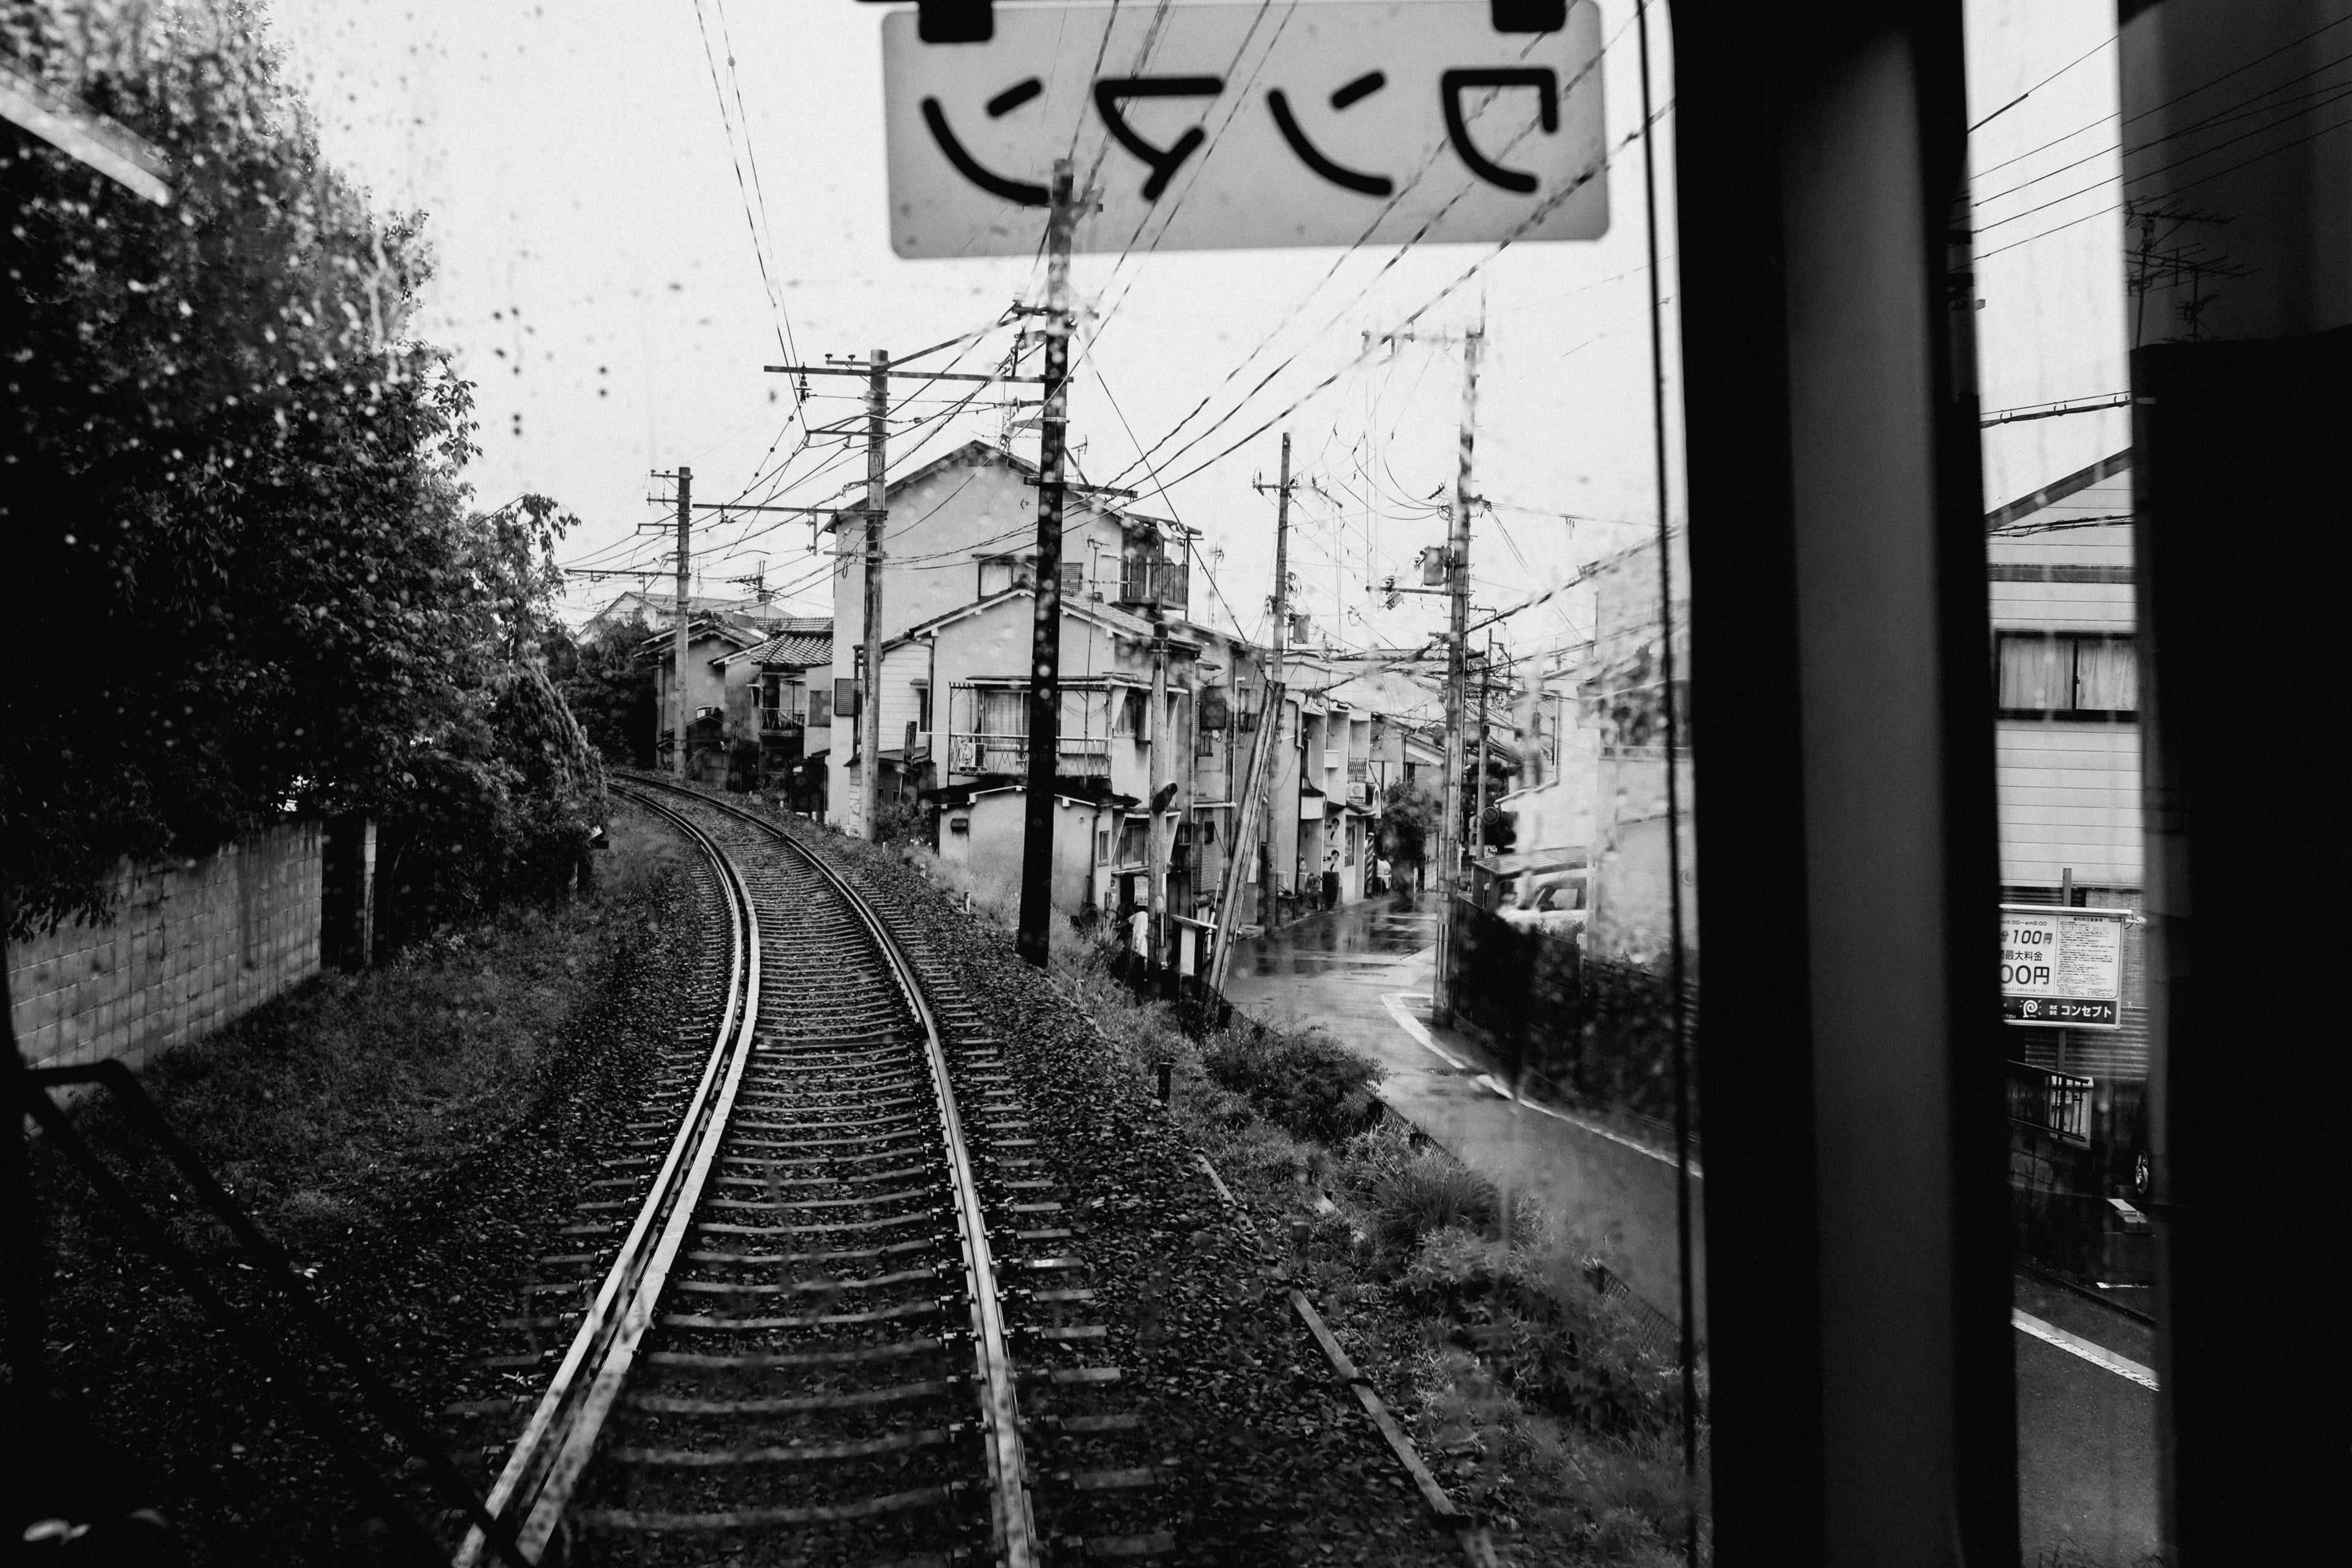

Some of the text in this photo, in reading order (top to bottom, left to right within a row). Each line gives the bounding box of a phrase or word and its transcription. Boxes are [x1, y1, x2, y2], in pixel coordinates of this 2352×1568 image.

[2061, 1005, 2112, 1018] コンセプト
